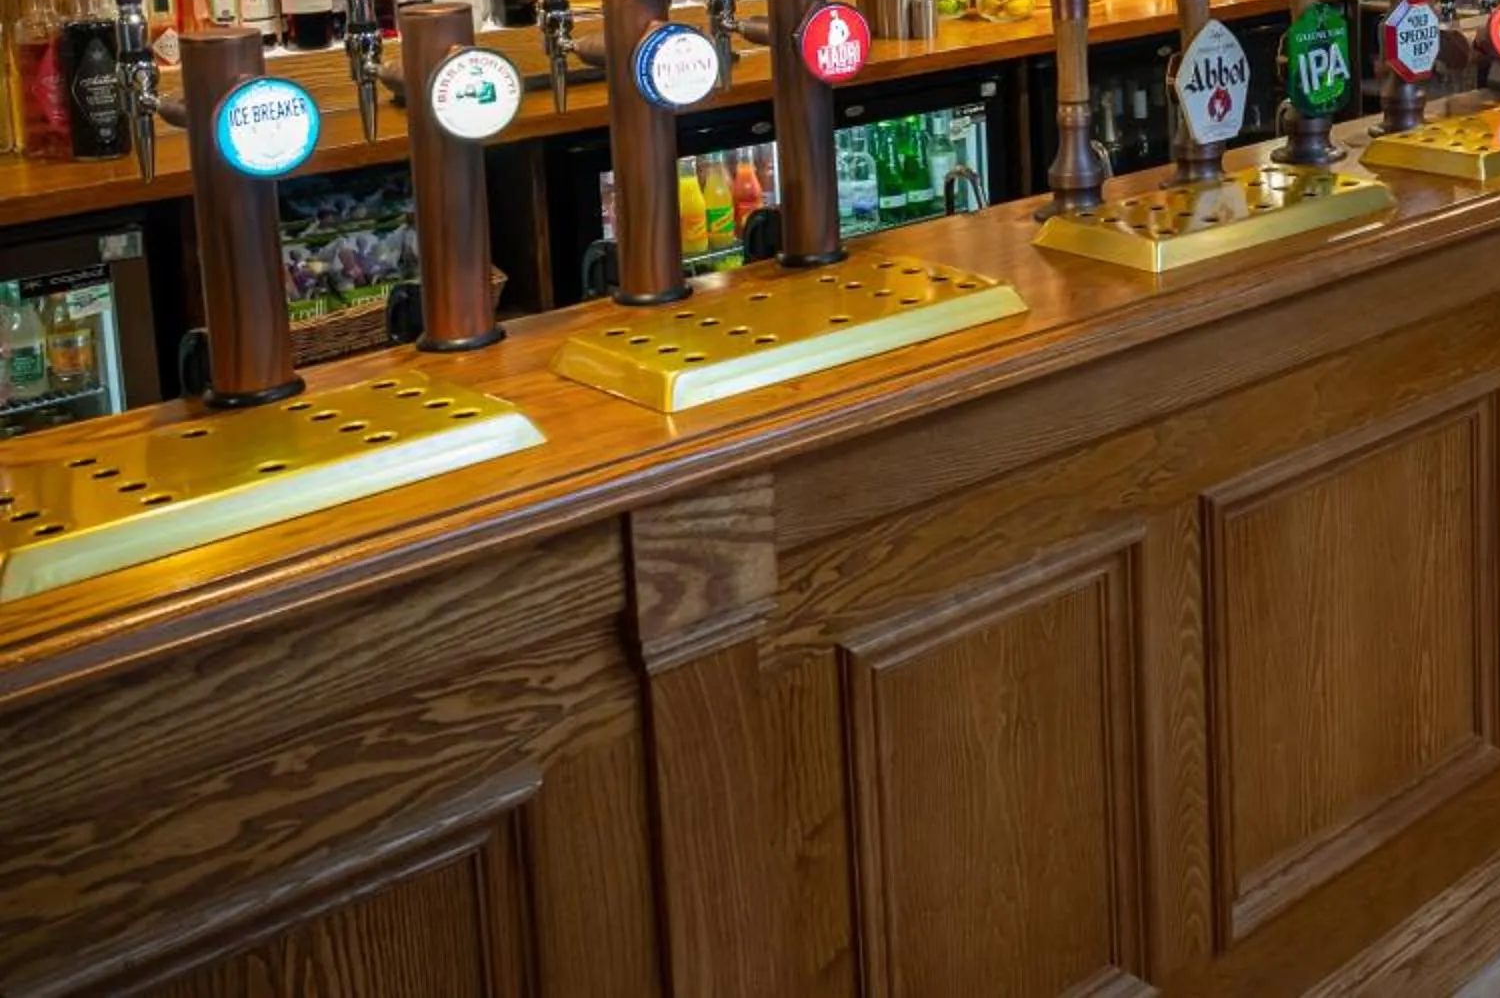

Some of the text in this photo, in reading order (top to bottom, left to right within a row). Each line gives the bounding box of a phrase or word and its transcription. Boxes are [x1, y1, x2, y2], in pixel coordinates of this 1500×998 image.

[1298, 42, 1351, 95] IPA
[228, 97, 308, 127] ICE BREAKER
